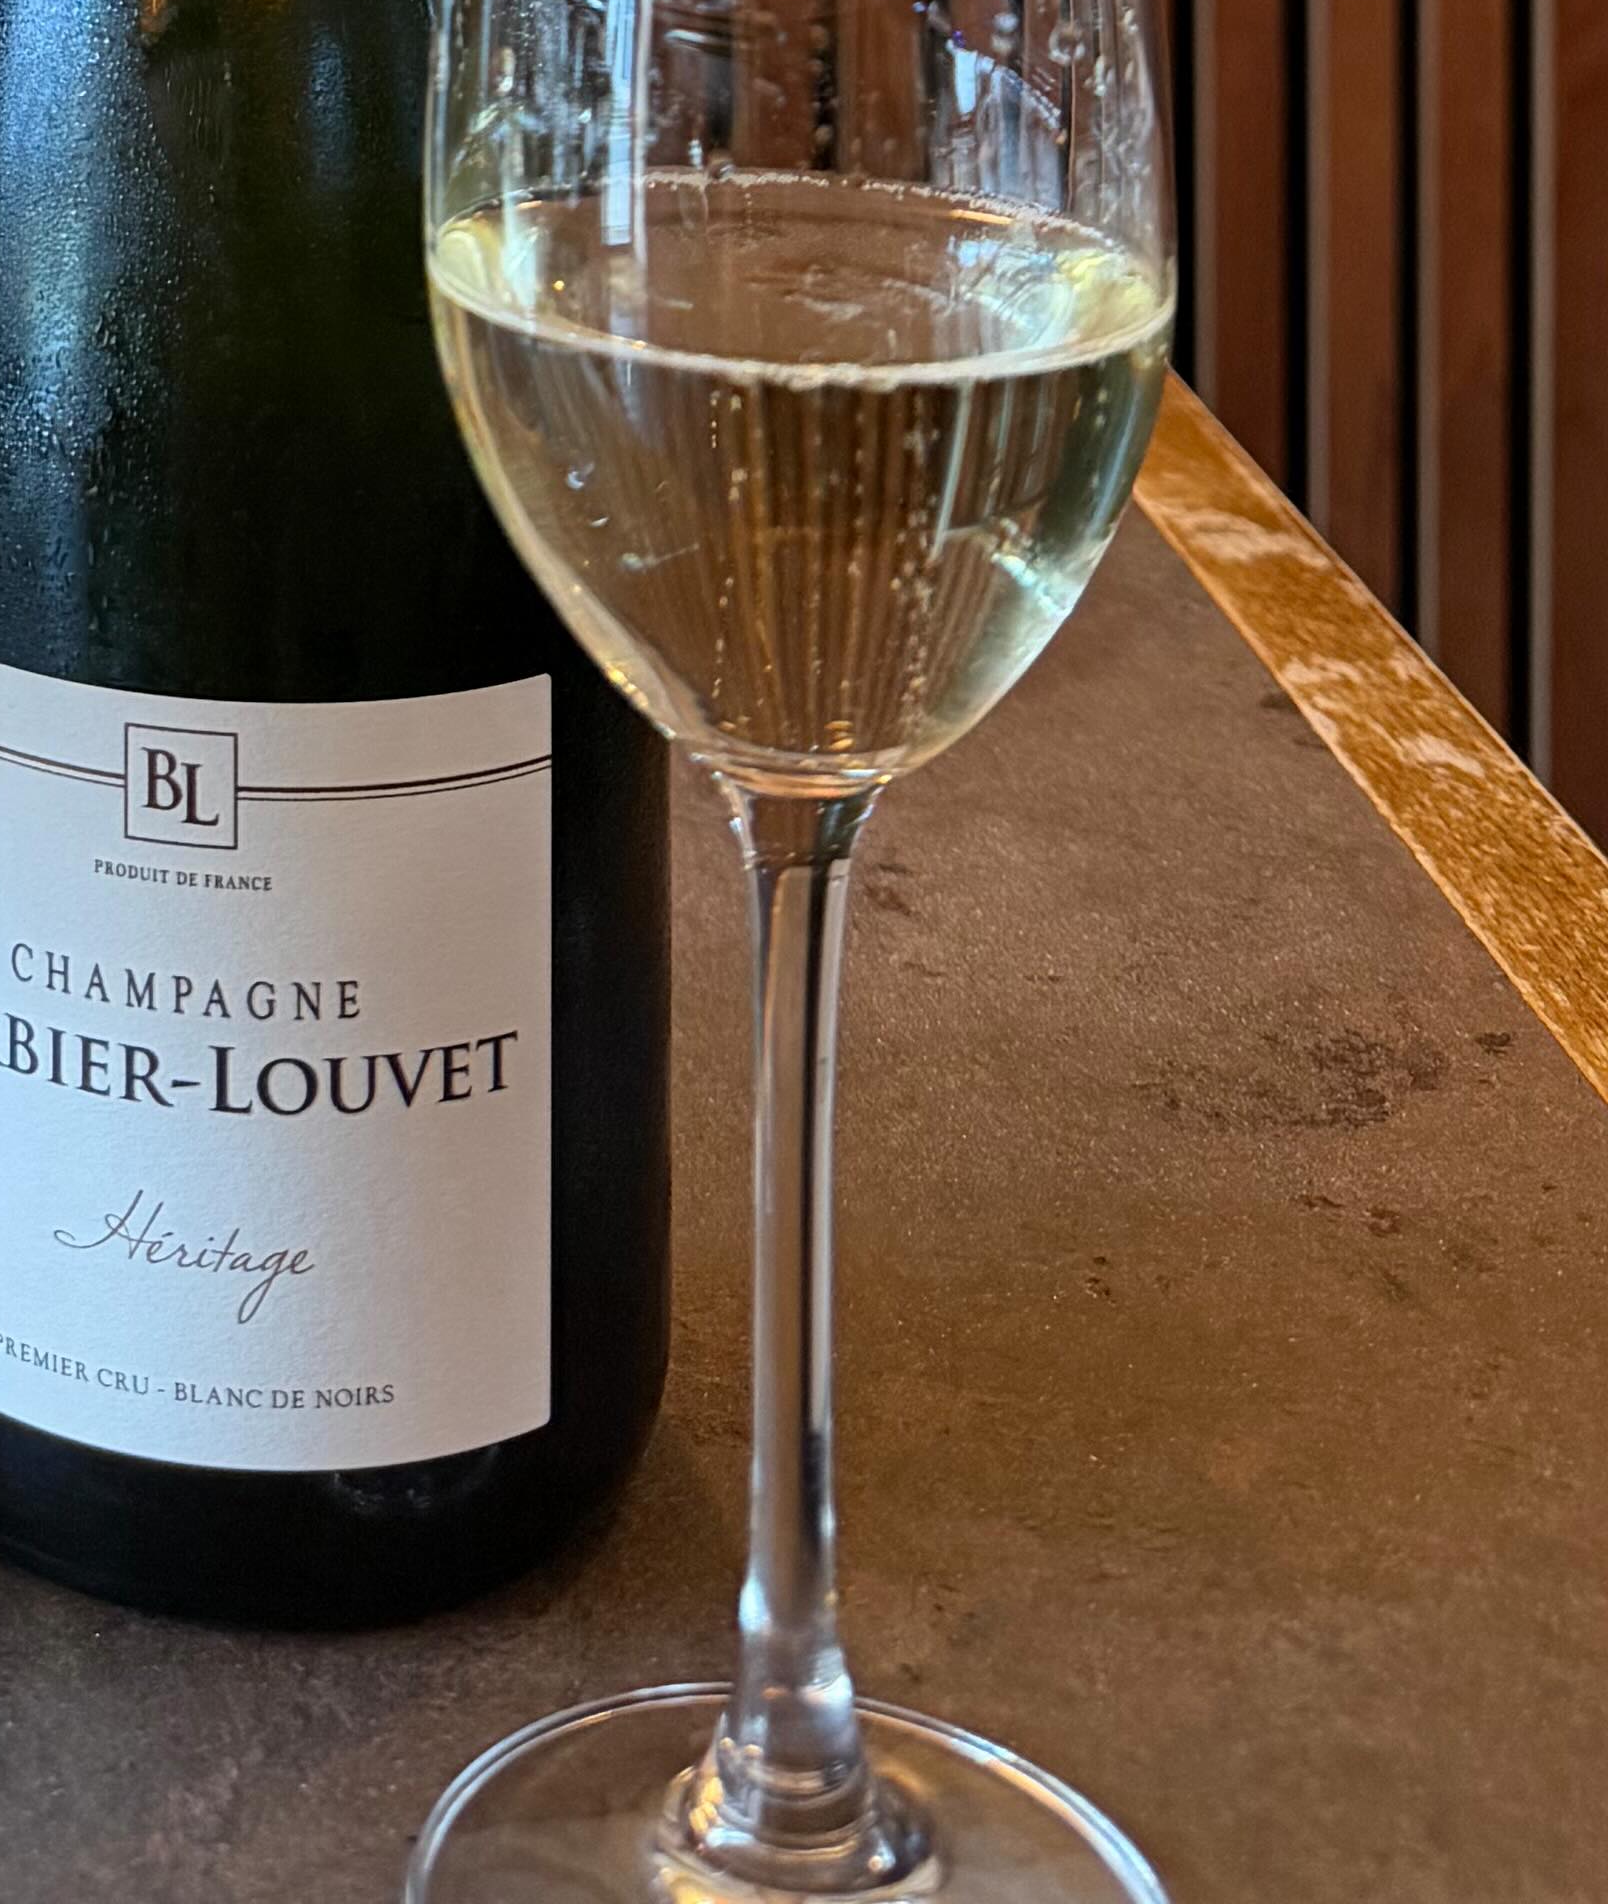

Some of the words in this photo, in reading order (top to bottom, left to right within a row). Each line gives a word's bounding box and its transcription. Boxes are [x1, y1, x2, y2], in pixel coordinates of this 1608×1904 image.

[140, 747, 220, 827] BL
[93, 858, 170, 885] PRODUIT
[176, 870, 199, 888] DE
[204, 873, 273, 892] FRANCE
[10, 942, 361, 1021] CHAMPAGNE
[53, 1190, 315, 1325] Héritage
[97, 1366, 150, 1396] CRU
[174, 1382, 263, 1410] BLANC
[271, 1388, 306, 1410] DE
[315, 1383, 396, 1410] NOIRS
